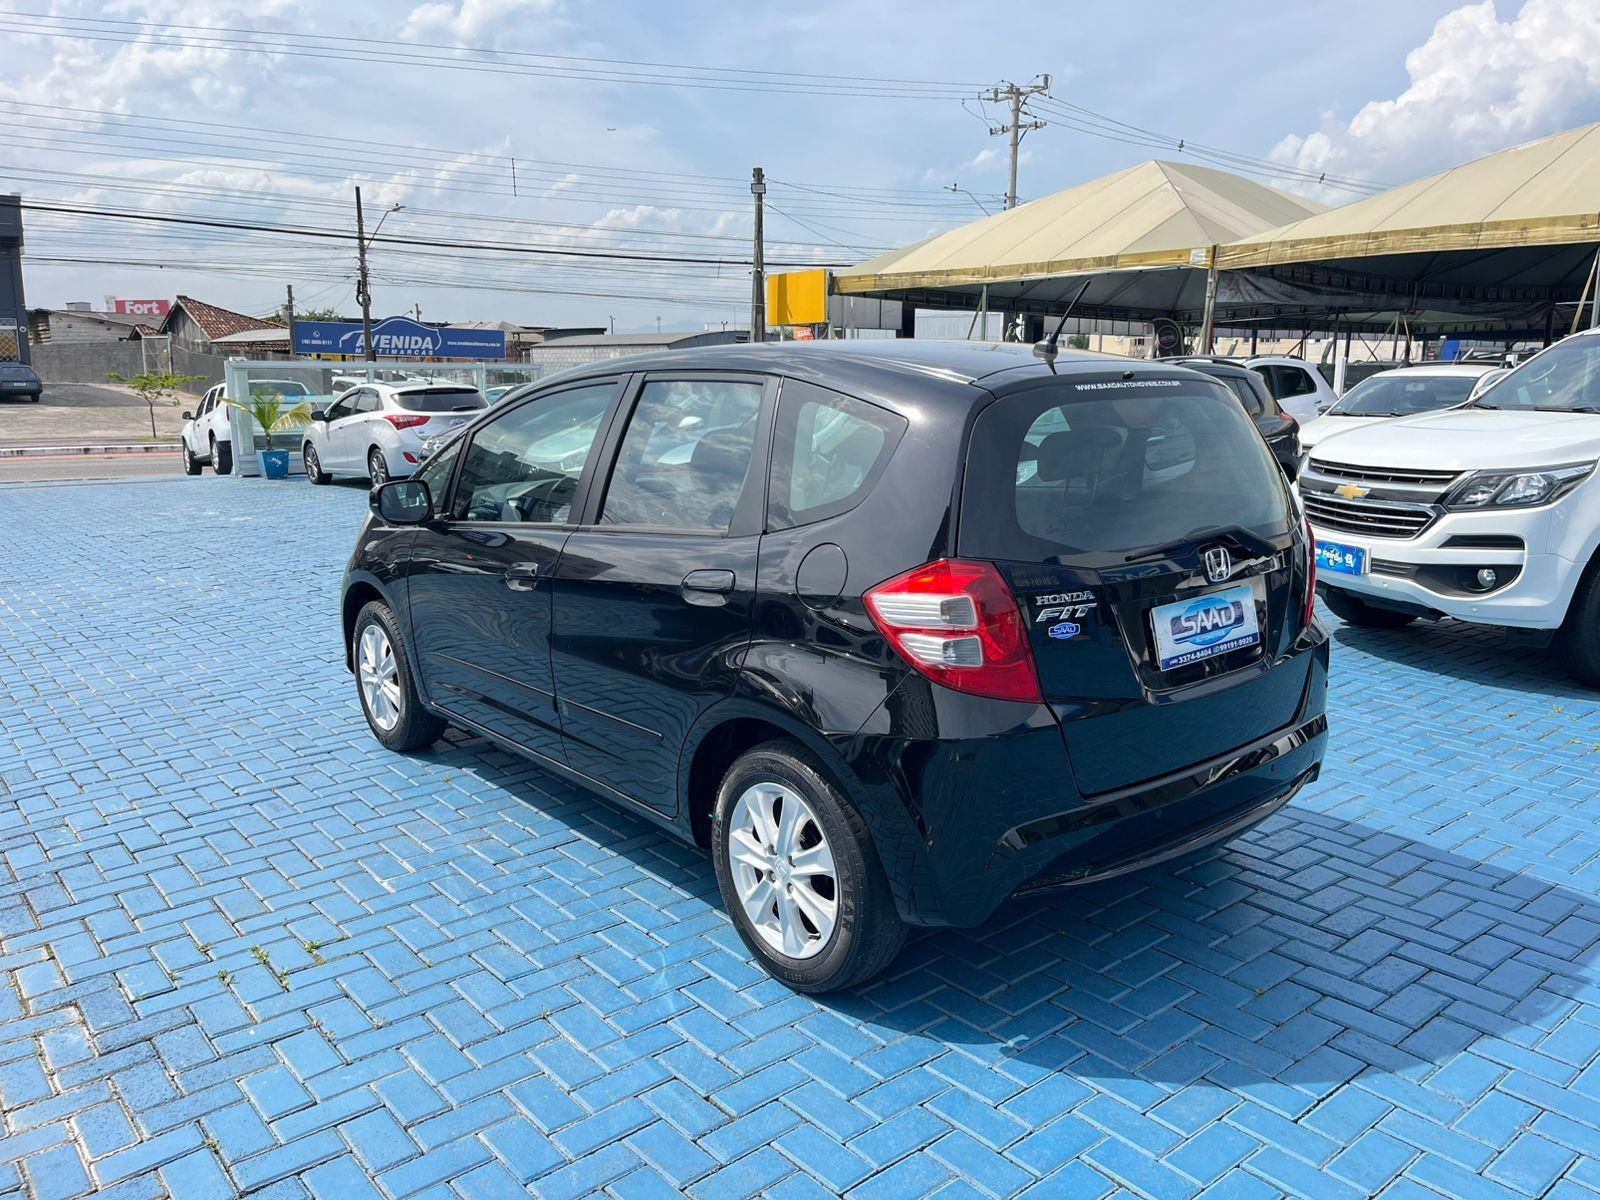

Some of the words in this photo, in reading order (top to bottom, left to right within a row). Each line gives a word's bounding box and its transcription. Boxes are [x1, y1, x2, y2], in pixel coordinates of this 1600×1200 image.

[125, 300, 160, 315] Fort
[355, 334, 433, 350] AVENIDA
[355, 348, 434, 356] MTIMARCAS
[1035, 590, 1095, 605] HONDA
[1035, 602, 1098, 623] FIT
[1181, 602, 1236, 635] SAAD
[1053, 624, 1076, 634] SAAD
